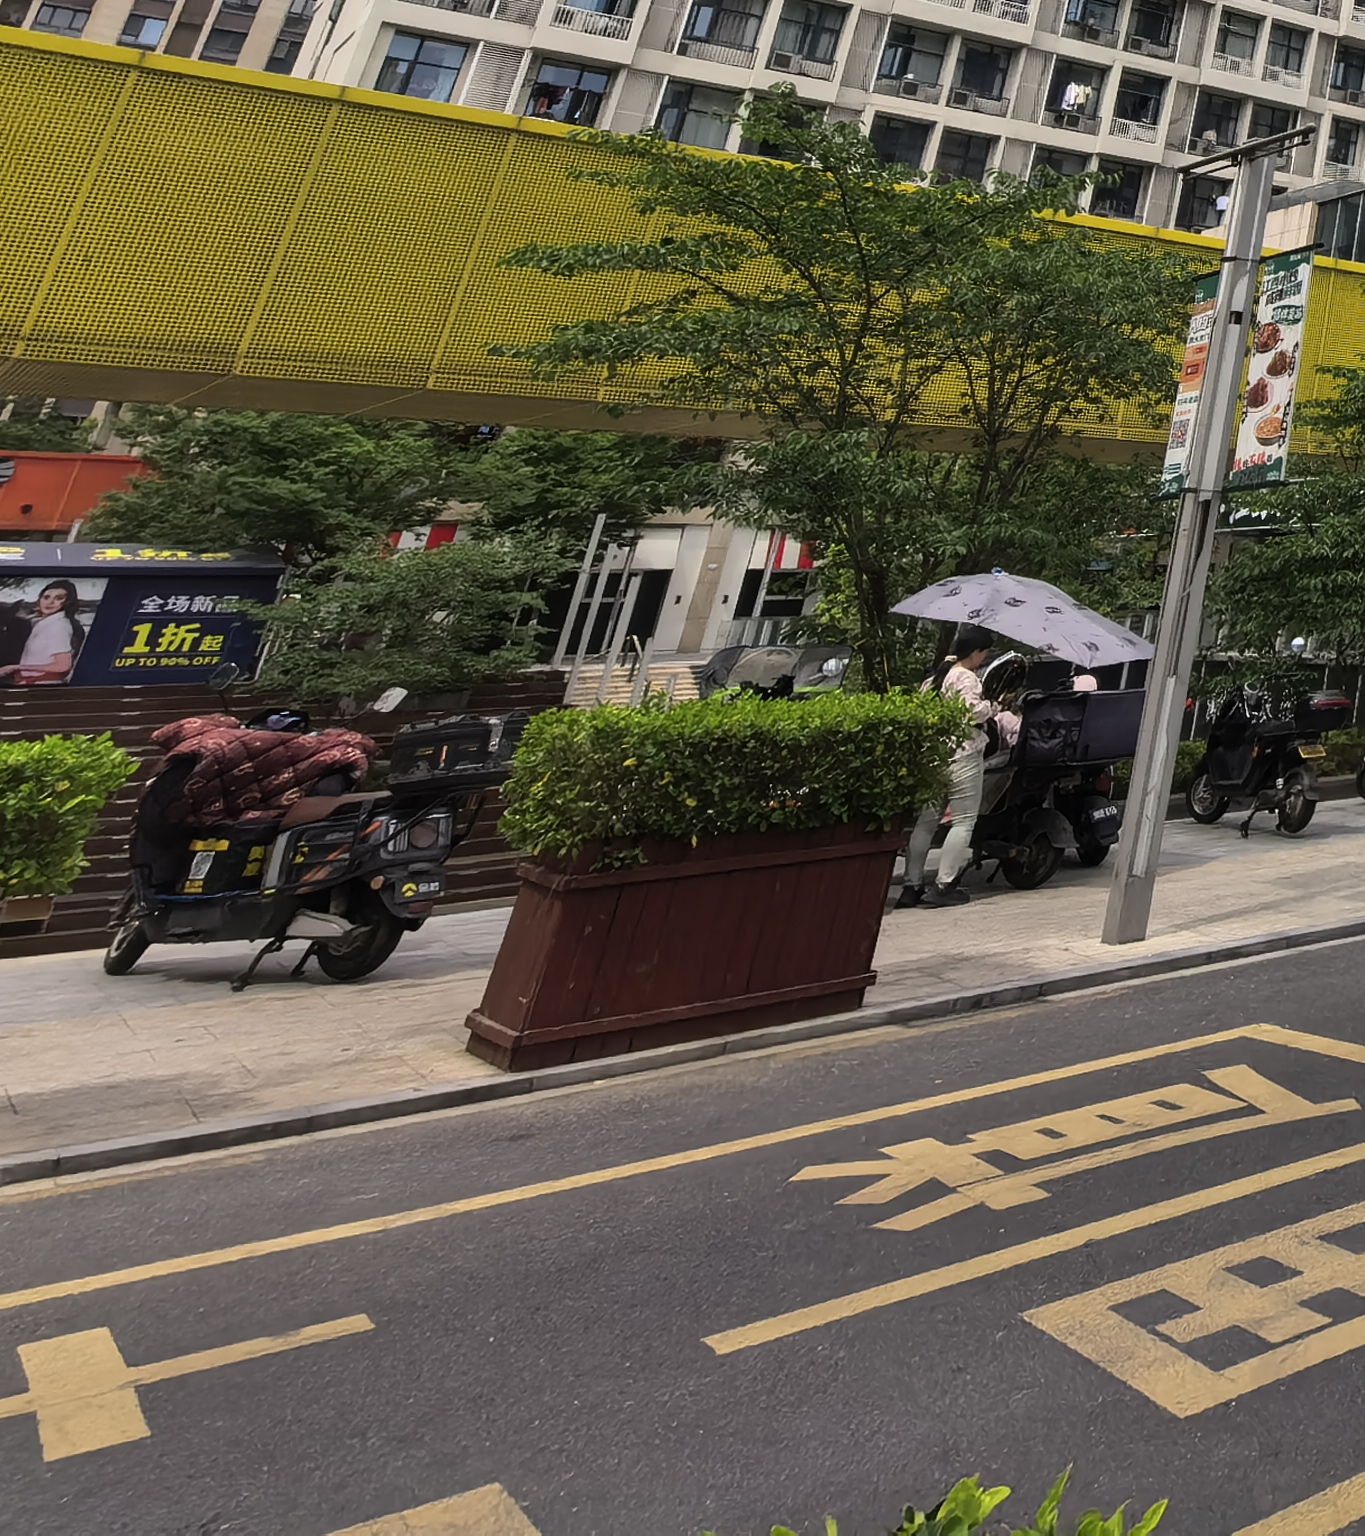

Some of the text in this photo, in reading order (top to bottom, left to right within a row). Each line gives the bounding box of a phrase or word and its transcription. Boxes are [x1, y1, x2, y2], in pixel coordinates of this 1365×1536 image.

[122, 622, 224, 654] 1折起
[115, 656, 221, 667] UP TO 90% OFF
